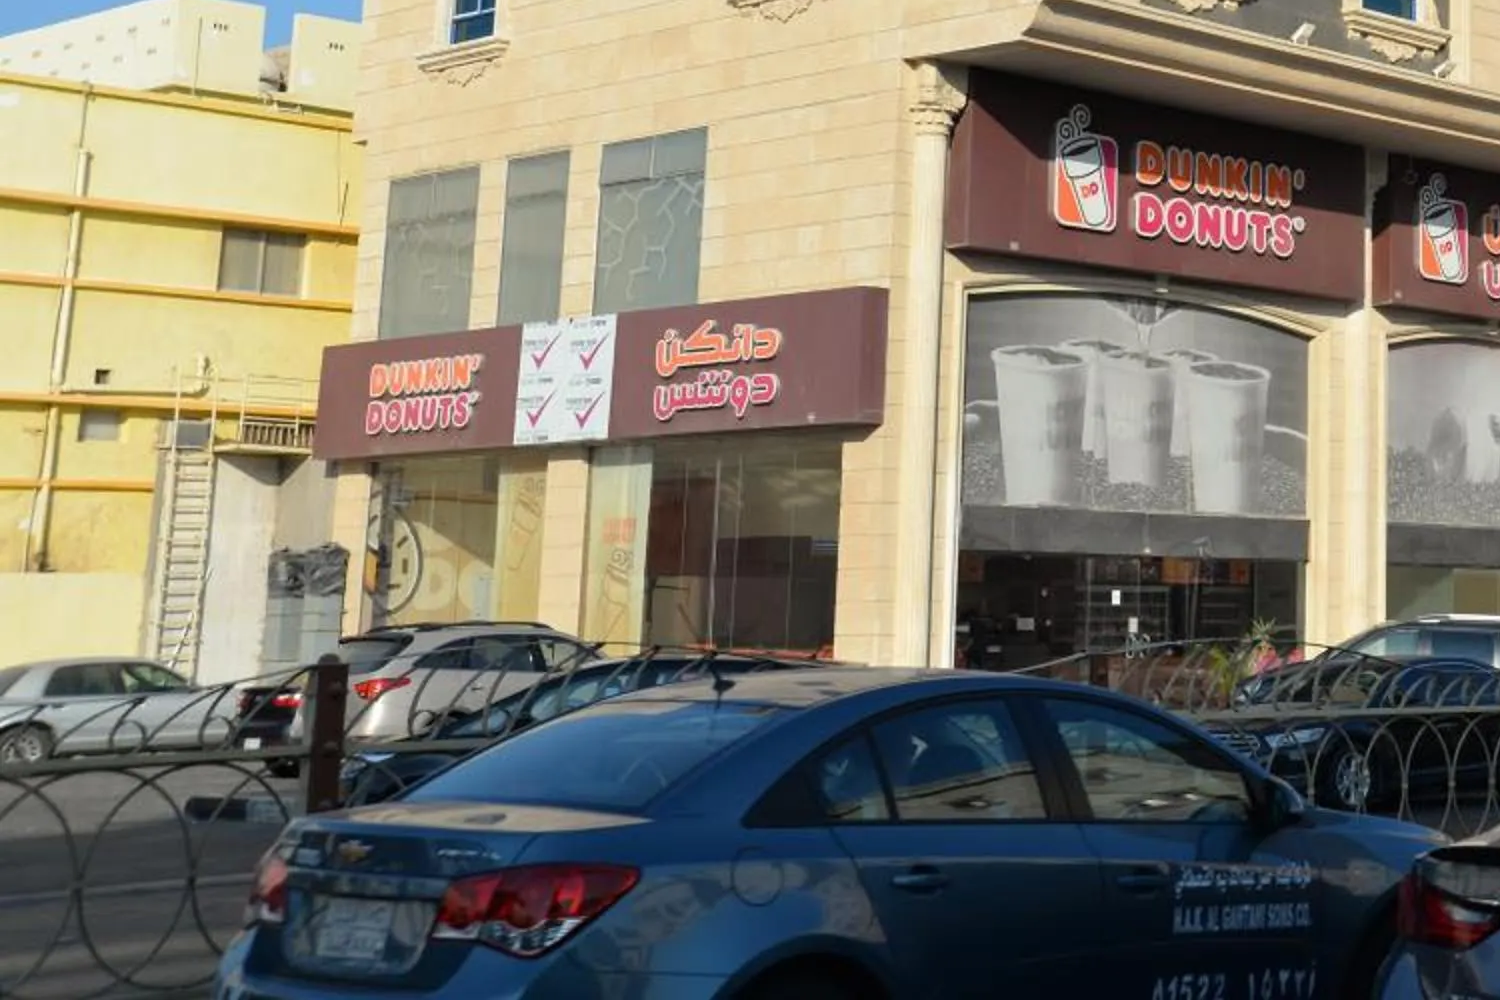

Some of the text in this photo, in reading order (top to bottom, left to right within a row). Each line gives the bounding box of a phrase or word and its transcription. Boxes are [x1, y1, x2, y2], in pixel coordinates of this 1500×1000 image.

[1133, 192, 1296, 258] DONUTS
[655, 319, 783, 378] دانكن
[365, 391, 471, 436] DONUTS
